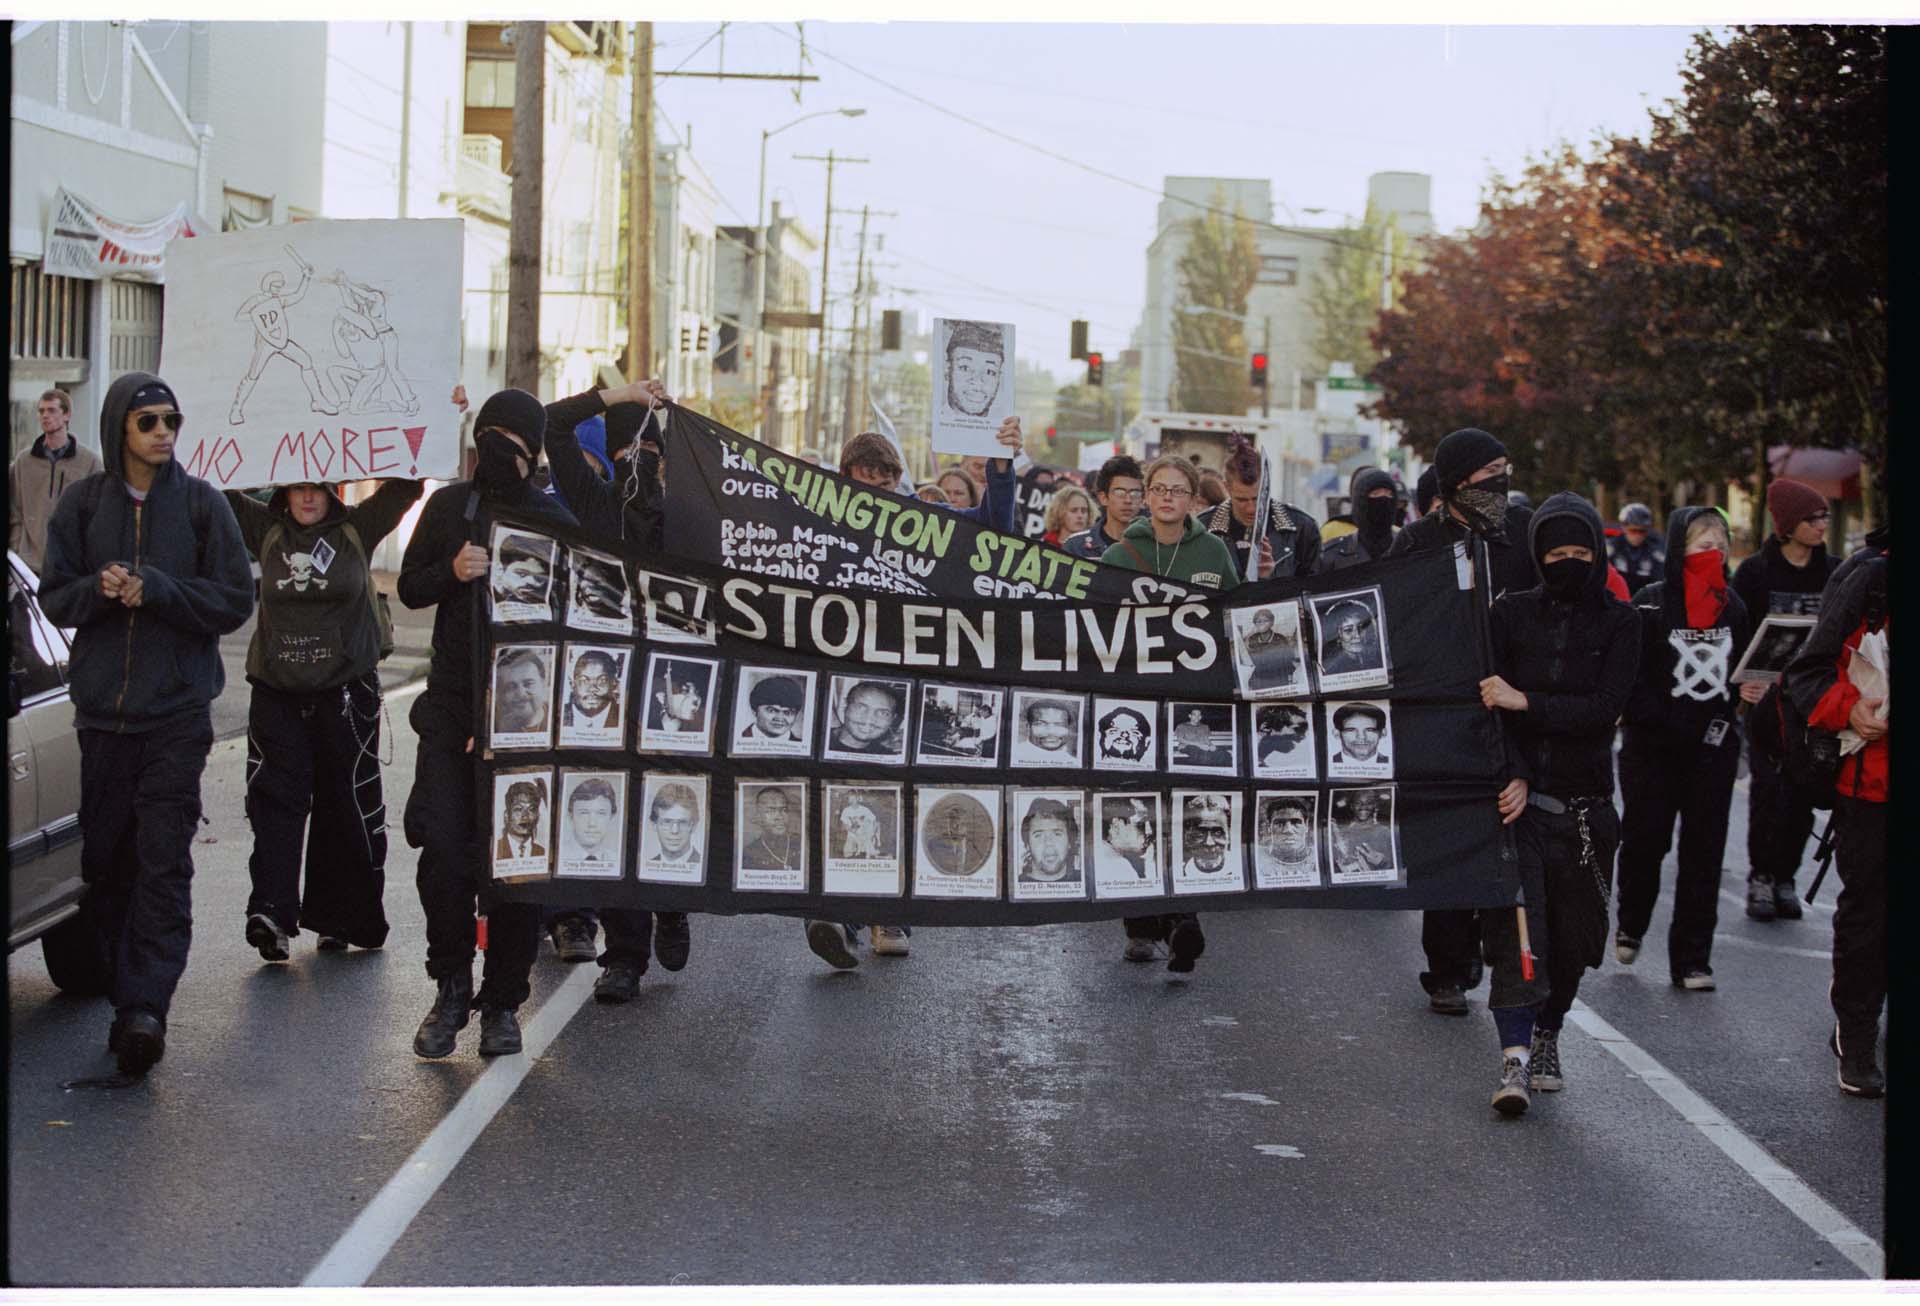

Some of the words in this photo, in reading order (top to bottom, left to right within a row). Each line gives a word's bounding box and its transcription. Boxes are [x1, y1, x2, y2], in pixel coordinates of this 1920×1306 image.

[259, 310, 278, 328] PD
[185, 436, 244, 485] NO
[270, 425, 428, 481] MORE!
[721, 478, 779, 500] OVER
[721, 518, 778, 541] Robin
[792, 525, 860, 554] Marie
[731, 441, 956, 558] ASHINGTON
[969, 530, 1097, 600] STATE
[721, 538, 828, 562] Edward
[872, 538, 937, 578] law
[722, 577, 996, 669] STOLEN
[1020, 604, 1218, 675] LIVES
